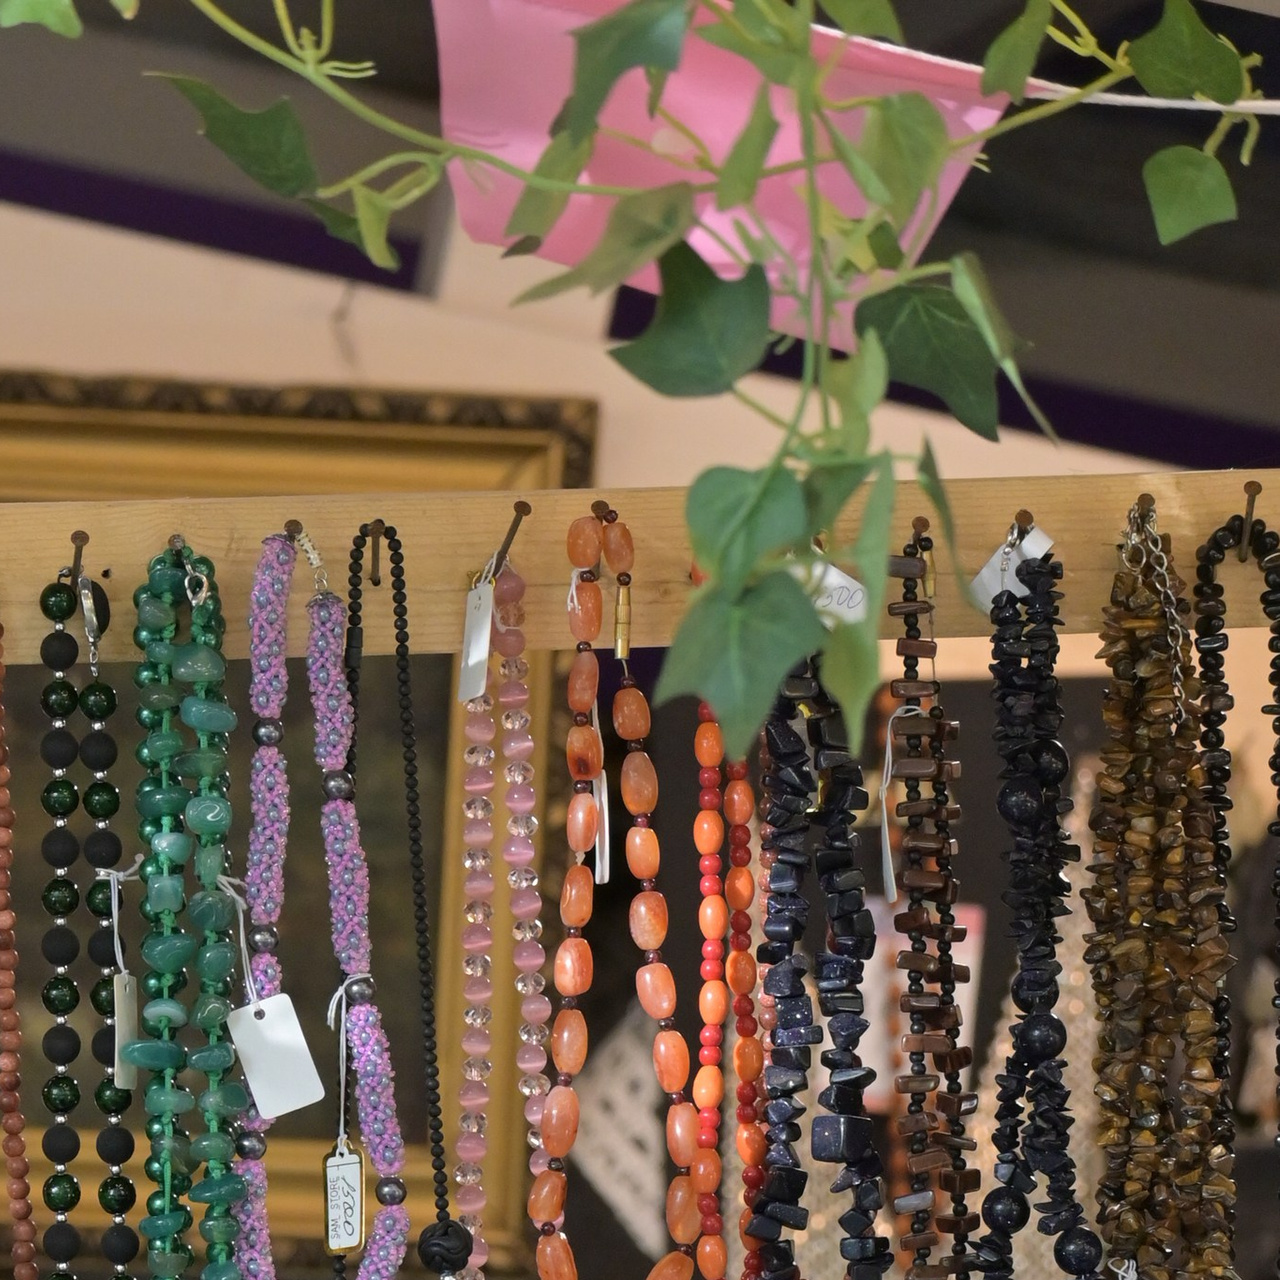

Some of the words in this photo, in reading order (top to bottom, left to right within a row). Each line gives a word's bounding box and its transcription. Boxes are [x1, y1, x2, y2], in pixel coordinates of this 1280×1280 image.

[329, 1177, 339, 1210] STORE
[341, 1175, 357, 1237] 1500
[330, 1217, 339, 1239] SAM
